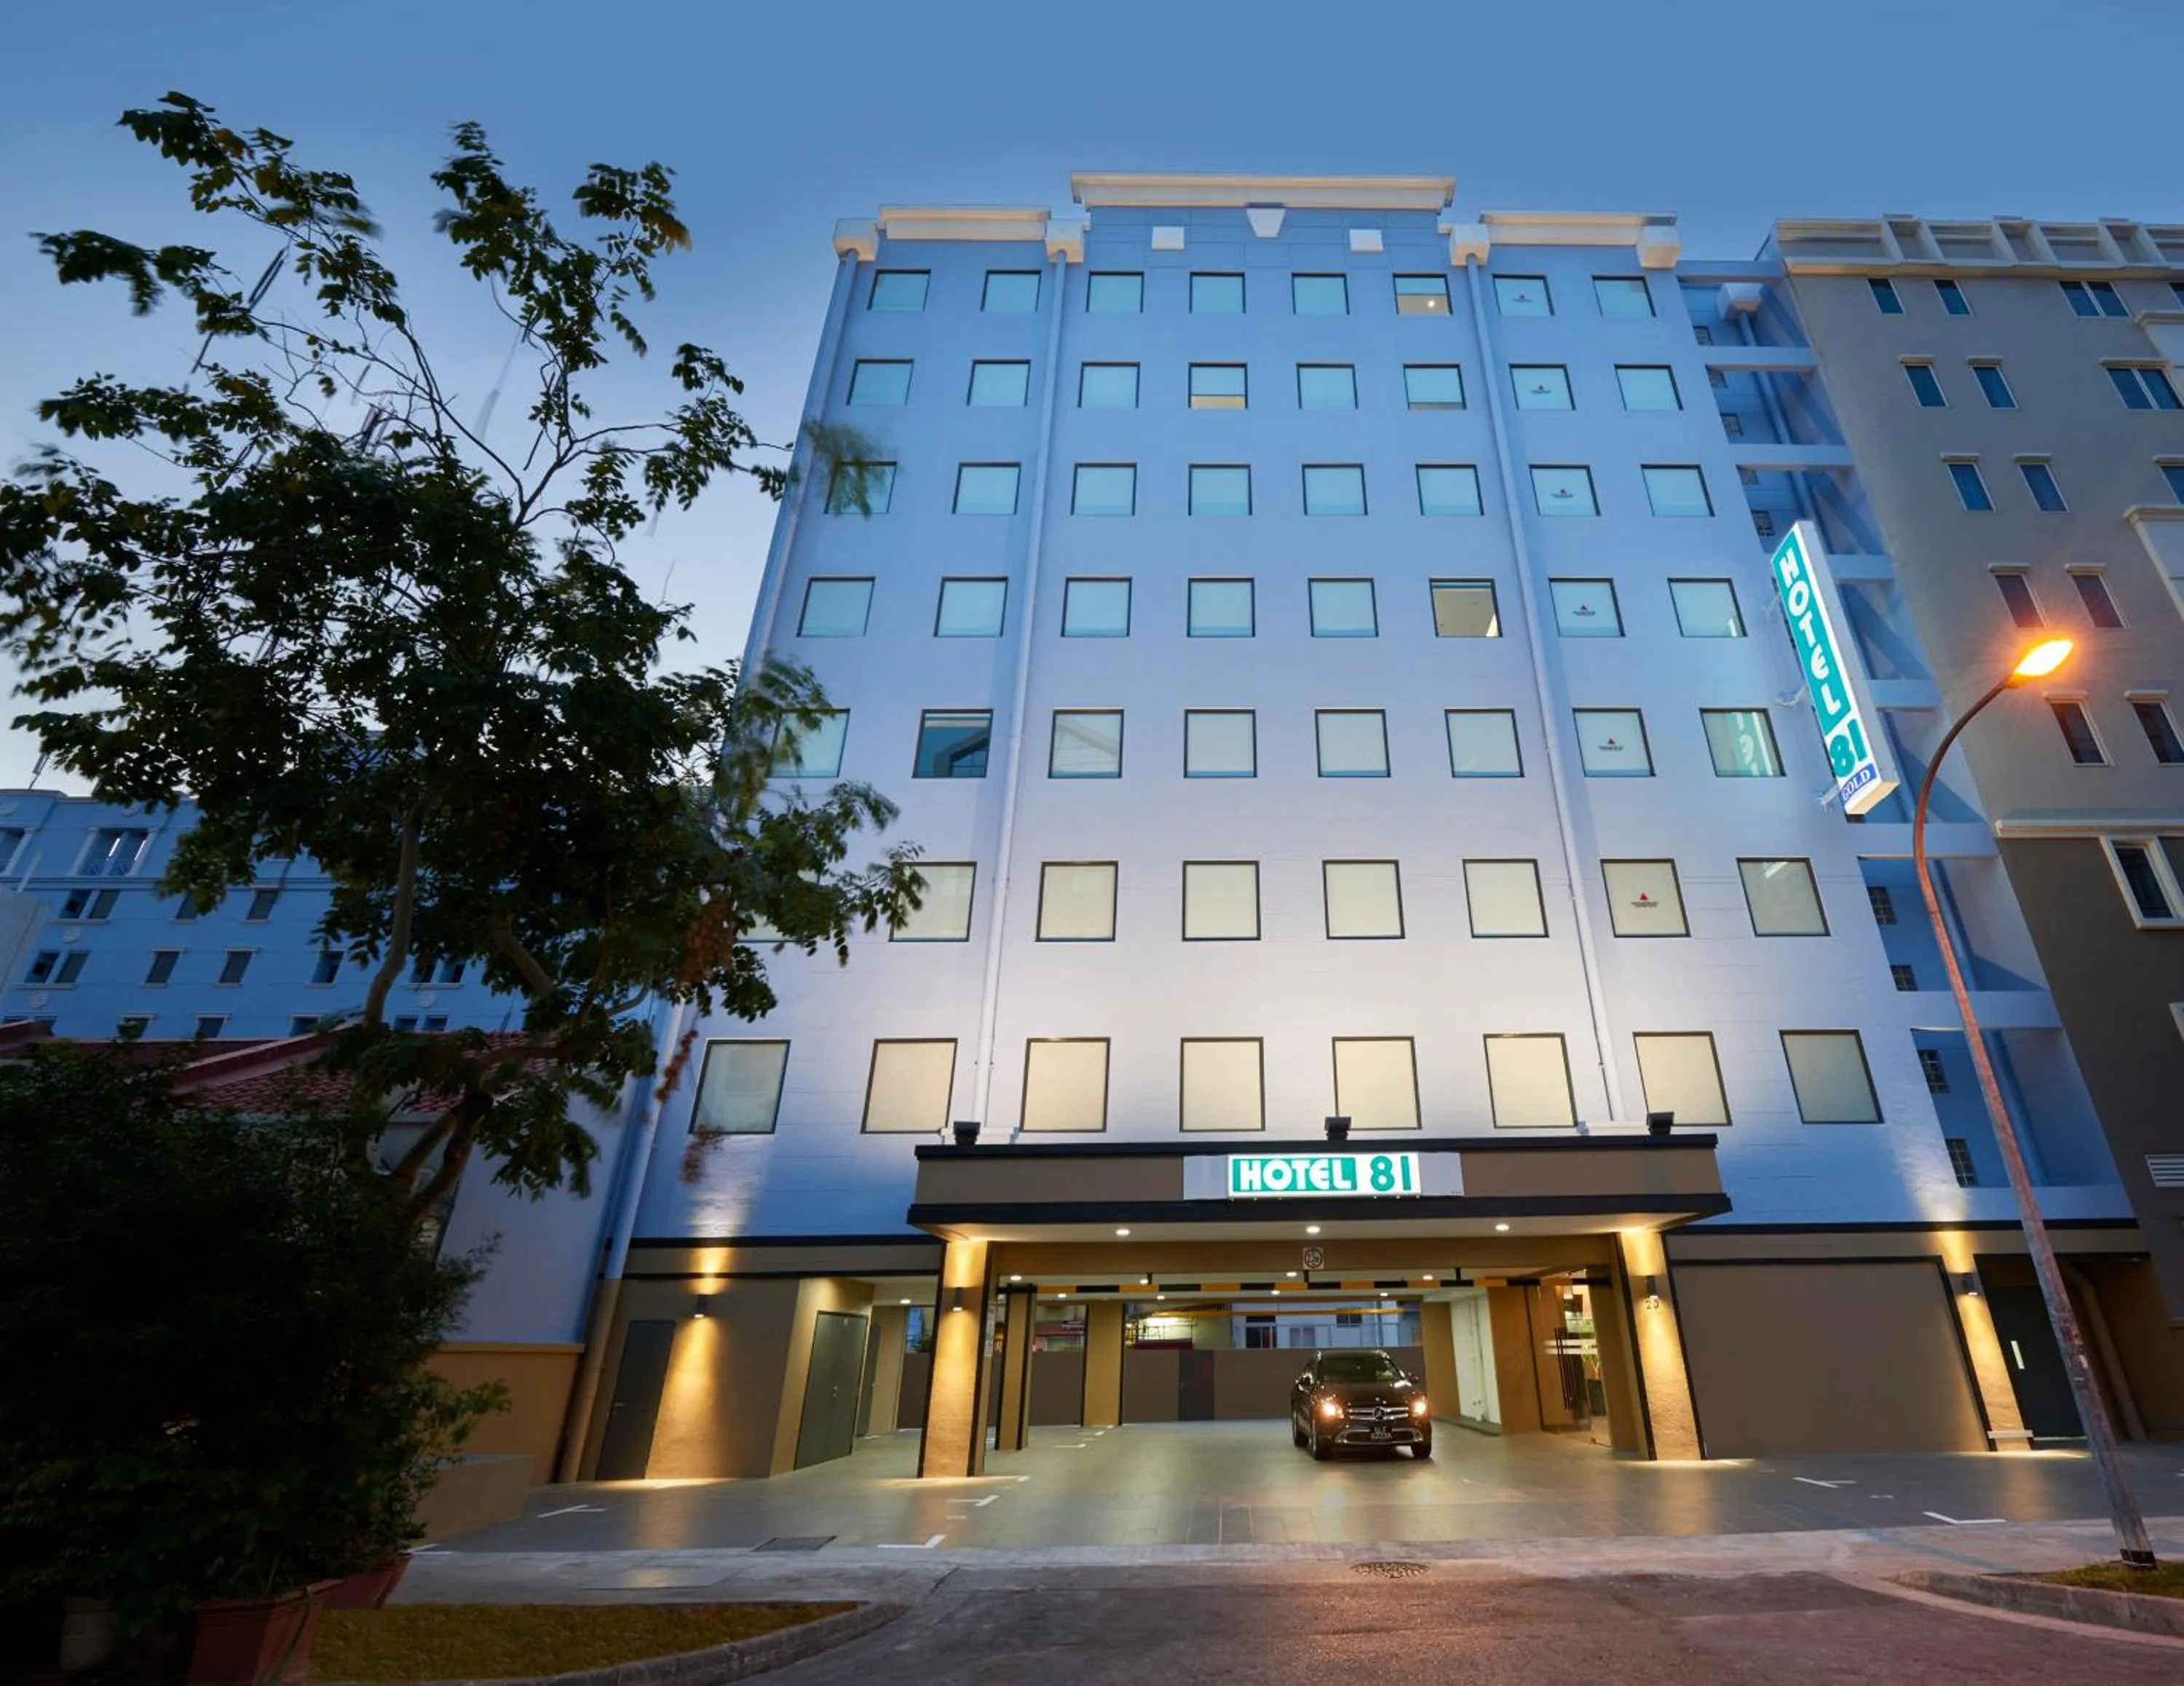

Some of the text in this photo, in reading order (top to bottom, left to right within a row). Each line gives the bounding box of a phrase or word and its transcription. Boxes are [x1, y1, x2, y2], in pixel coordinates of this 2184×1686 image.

[1779, 547, 1841, 716] HOTEL
[1829, 719, 1867, 777] 81
[1841, 769, 1871, 802] GOLD
[1240, 1156, 1412, 1192] HOTEL 81
